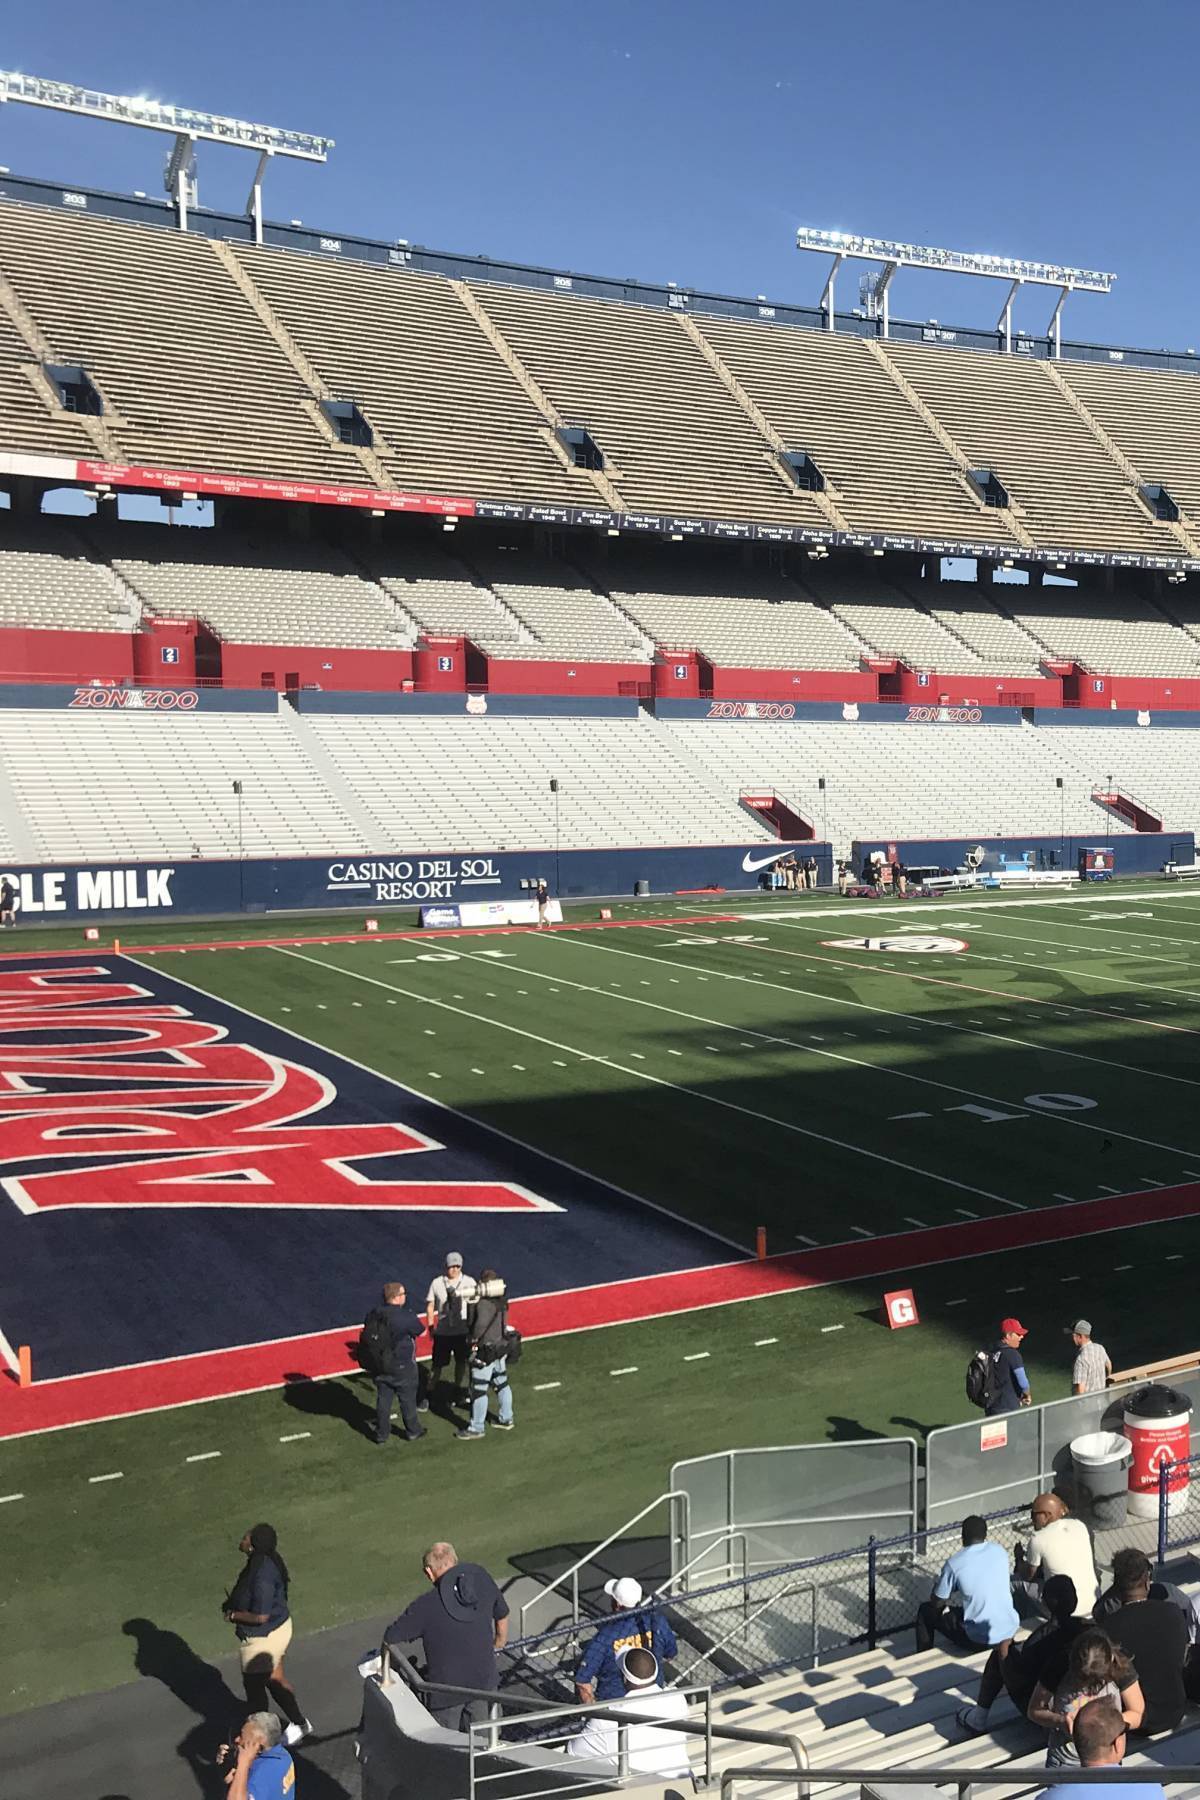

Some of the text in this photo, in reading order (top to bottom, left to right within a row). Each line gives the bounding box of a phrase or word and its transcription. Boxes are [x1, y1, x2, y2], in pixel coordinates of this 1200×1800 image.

[63, 193, 87, 206] 203
[320, 239, 342, 249] 204
[327, 859, 500, 882] CASINO DEL SOL
[77, 868, 174, 911] MILK
[375, 880, 457, 901] RESORT
[943, 1092, 1099, 1123] 10
[890, 1297, 915, 1324] G
